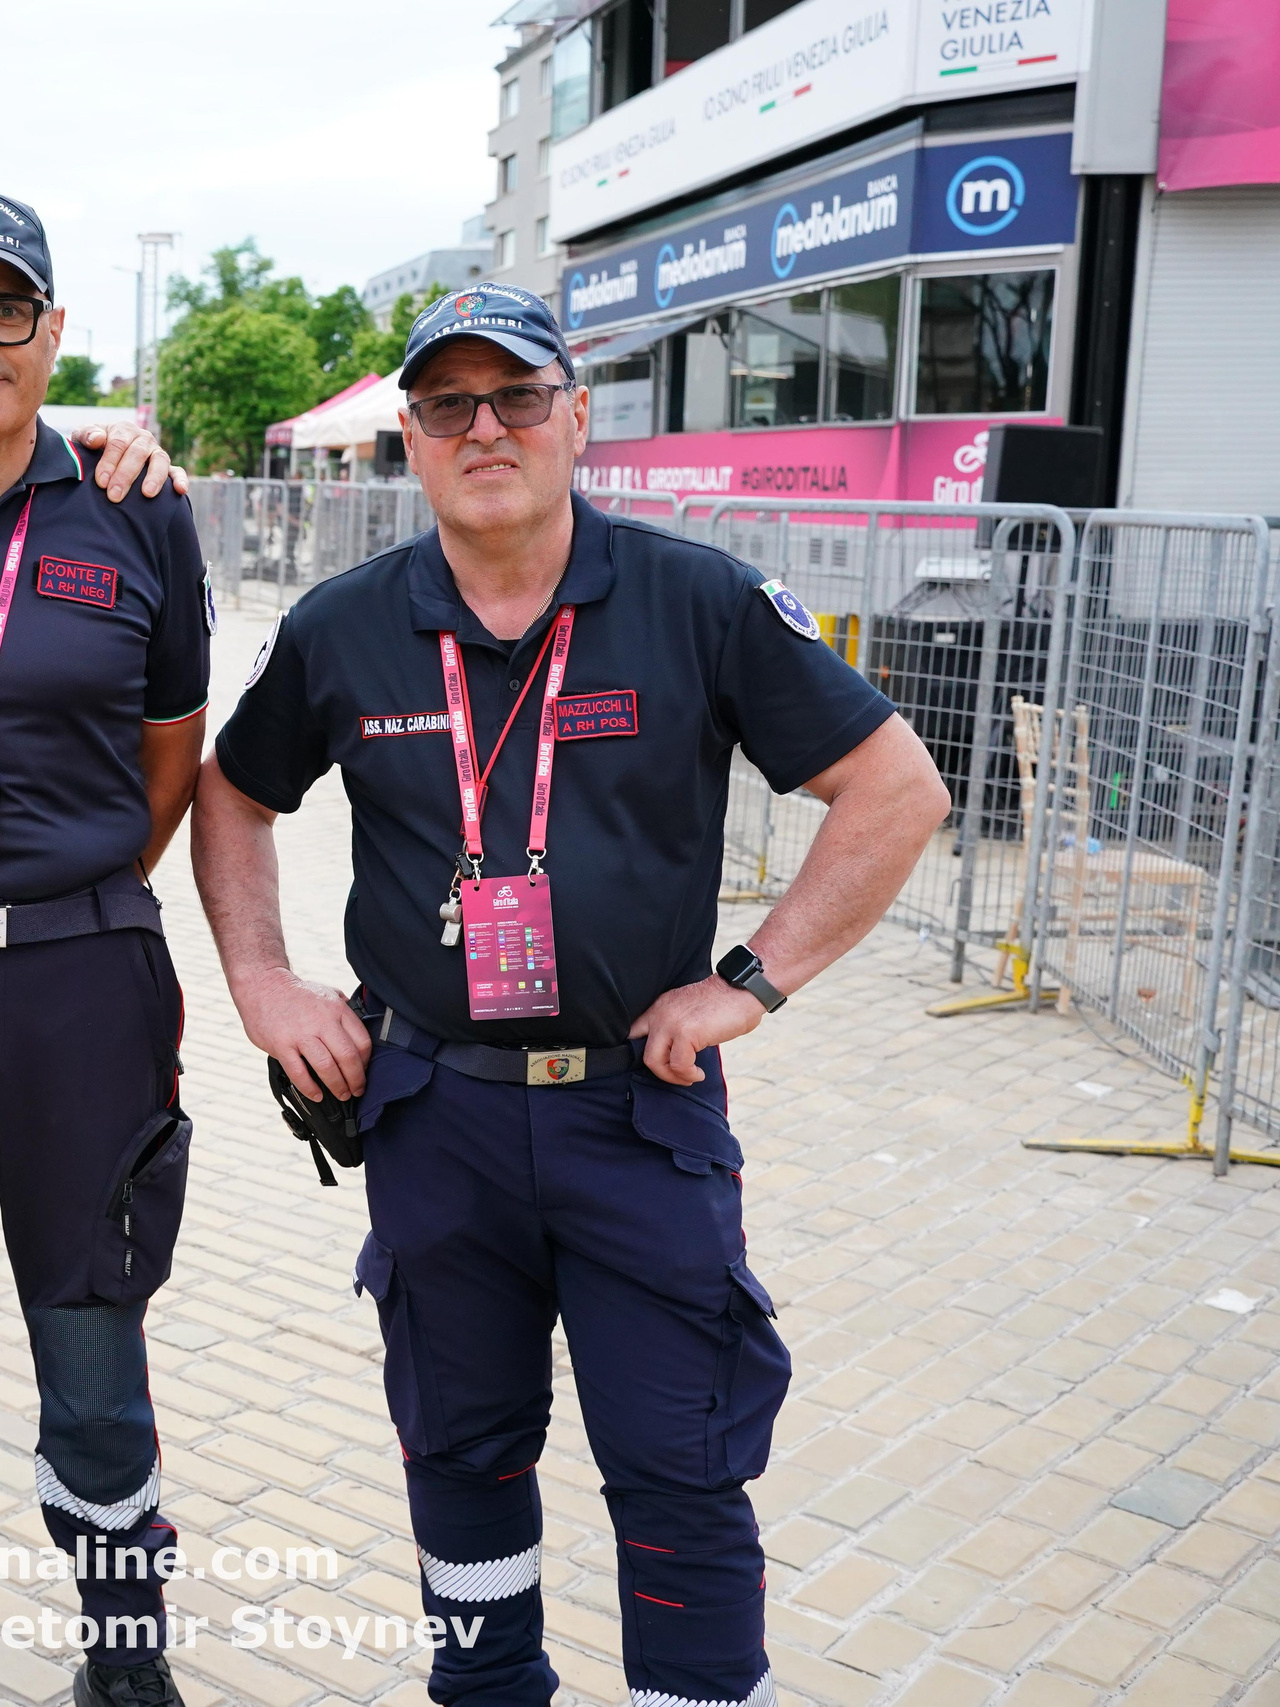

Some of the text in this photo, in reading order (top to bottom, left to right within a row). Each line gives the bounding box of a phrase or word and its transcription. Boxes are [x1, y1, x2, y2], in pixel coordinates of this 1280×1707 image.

[942, 0, 1051, 30] VENEZIA
[940, 30, 1023, 60] GIULIA
[867, 174, 898, 199] BANCA
[961, 178, 1012, 214] m
[776, 193, 898, 259] mediolanum
[657, 238, 747, 291] mediolanum
[480, 286, 531, 307] NAZIONALE
[570, 269, 638, 314] mediolanum
[741, 464, 848, 492] #GIRODITALIA
[933, 475, 970, 504] Giro
[6, 541, 22, 572] Giro d'Italia
[45, 562, 112, 587] CONTE P.
[45, 579, 108, 601] A RH NEG.
[554, 624, 570, 658] Giro d'Italia
[445, 653, 456, 667] Giro
[550, 663, 563, 677] Giro
[448, 672, 461, 705] Giro d'Italia
[558, 699, 622, 718] MAZZUCCHI
[364, 719, 383, 736] ASS.
[384, 718, 405, 734] NAZ.
[452, 710, 467, 744] Giro d'Italia
[562, 717, 631, 733] A RH POS.
[458, 749, 472, 783] Giro d'Italia
[538, 742, 552, 776] Giro d'Italia
[463, 788, 477, 822] Giro d'Italia
[534, 782, 548, 816] Giro d'Italia
